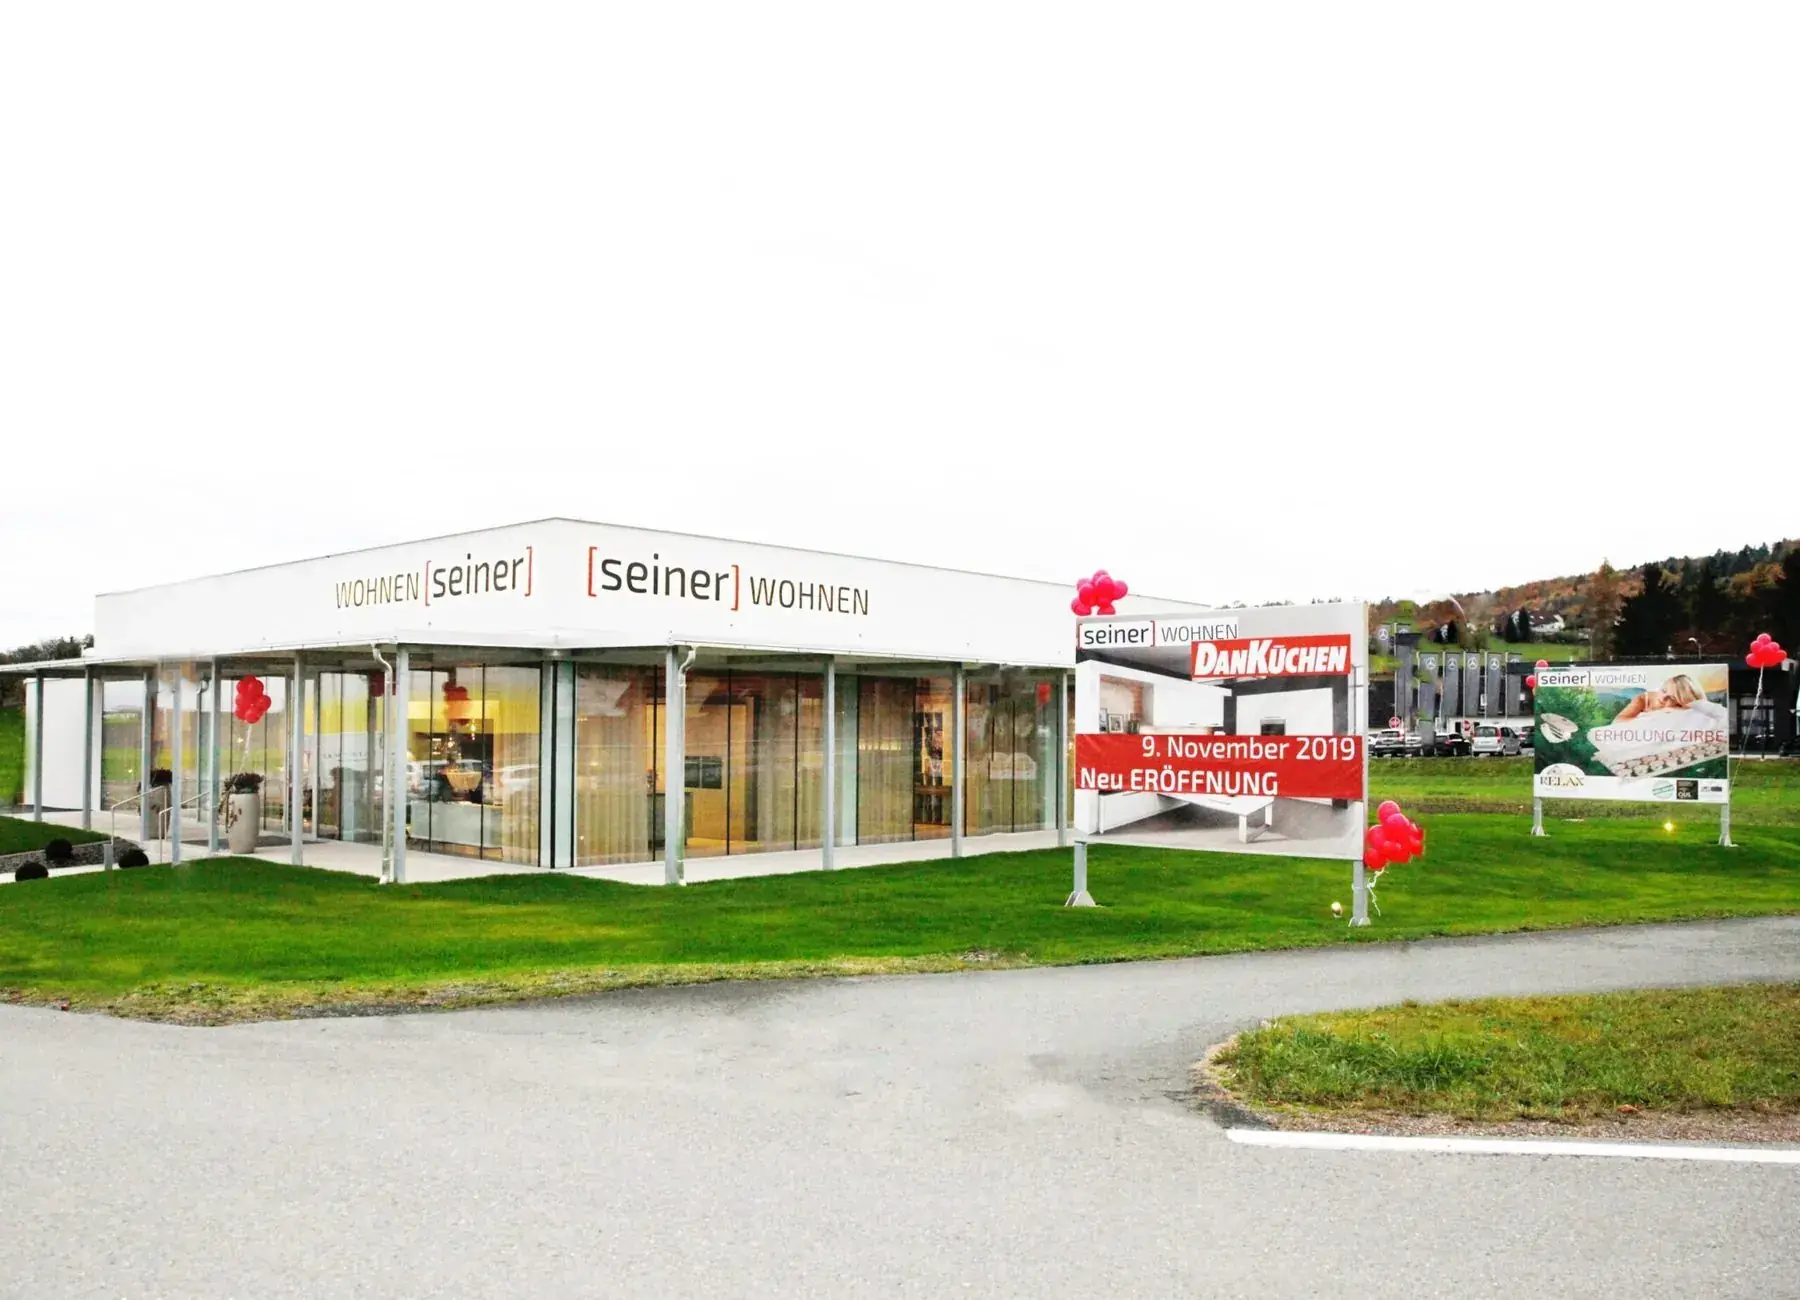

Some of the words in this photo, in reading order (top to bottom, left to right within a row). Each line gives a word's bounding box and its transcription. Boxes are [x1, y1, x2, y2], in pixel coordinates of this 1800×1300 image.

[336, 572, 419, 609] WOHNEN
[750, 576, 869, 615] WOHNEN
[1161, 623, 1238, 643] WOHNEN
[1594, 673, 1647, 684] WOHNEN
[1594, 729, 1676, 742] ERHOLUNG
[1142, 736, 1161, 758] 9.
[1167, 737, 1290, 760] November
[1295, 737, 1356, 761] 2019
[1080, 767, 1123, 789] Neu
[1130, 765, 1278, 796] ERÖFFNUNG
[1540, 776, 1585, 787] RELAX
